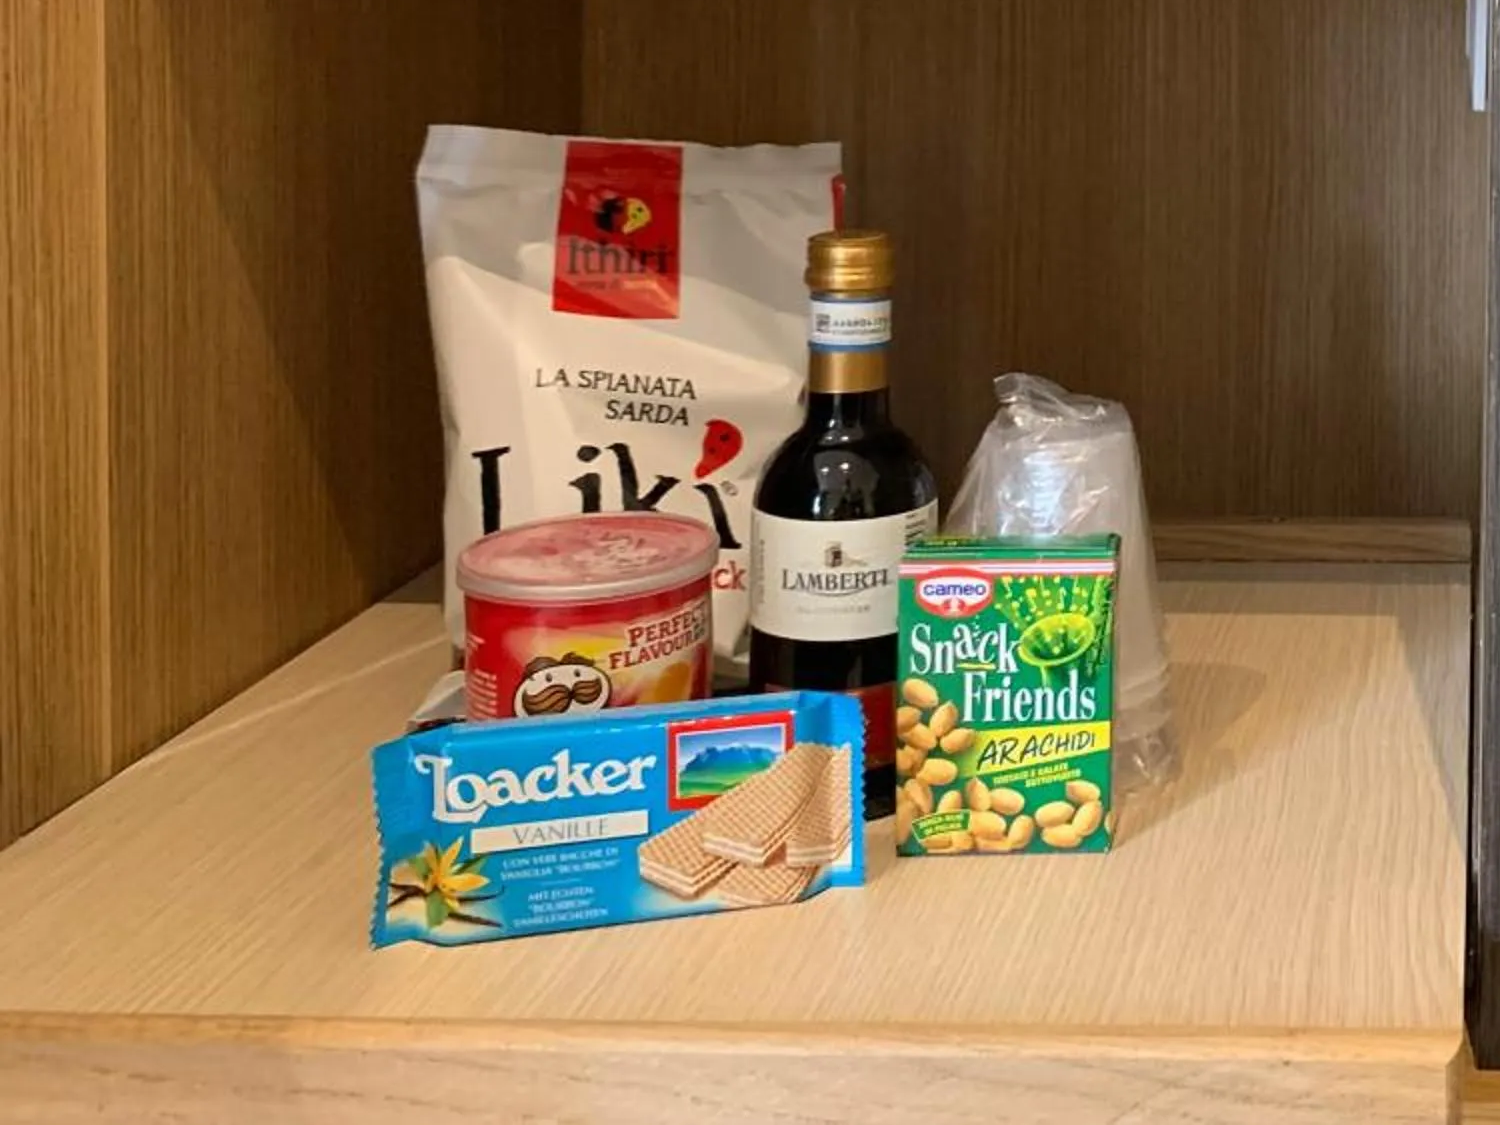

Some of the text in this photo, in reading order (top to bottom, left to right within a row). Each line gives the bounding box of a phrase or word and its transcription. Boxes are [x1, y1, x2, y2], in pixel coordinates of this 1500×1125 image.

[535, 368, 697, 401] LA SPIANATA
[604, 399, 690, 426] SARDA
[712, 560, 748, 593] ck
[782, 568, 893, 592] LAMBERTI
[923, 583, 987, 597] cameo
[910, 622, 1020, 674] Snack
[962, 668, 1097, 723] Friends
[976, 730, 1096, 770] ARACHIDI
[414, 748, 658, 825] Loacker
[511, 817, 611, 845] VANILLE
